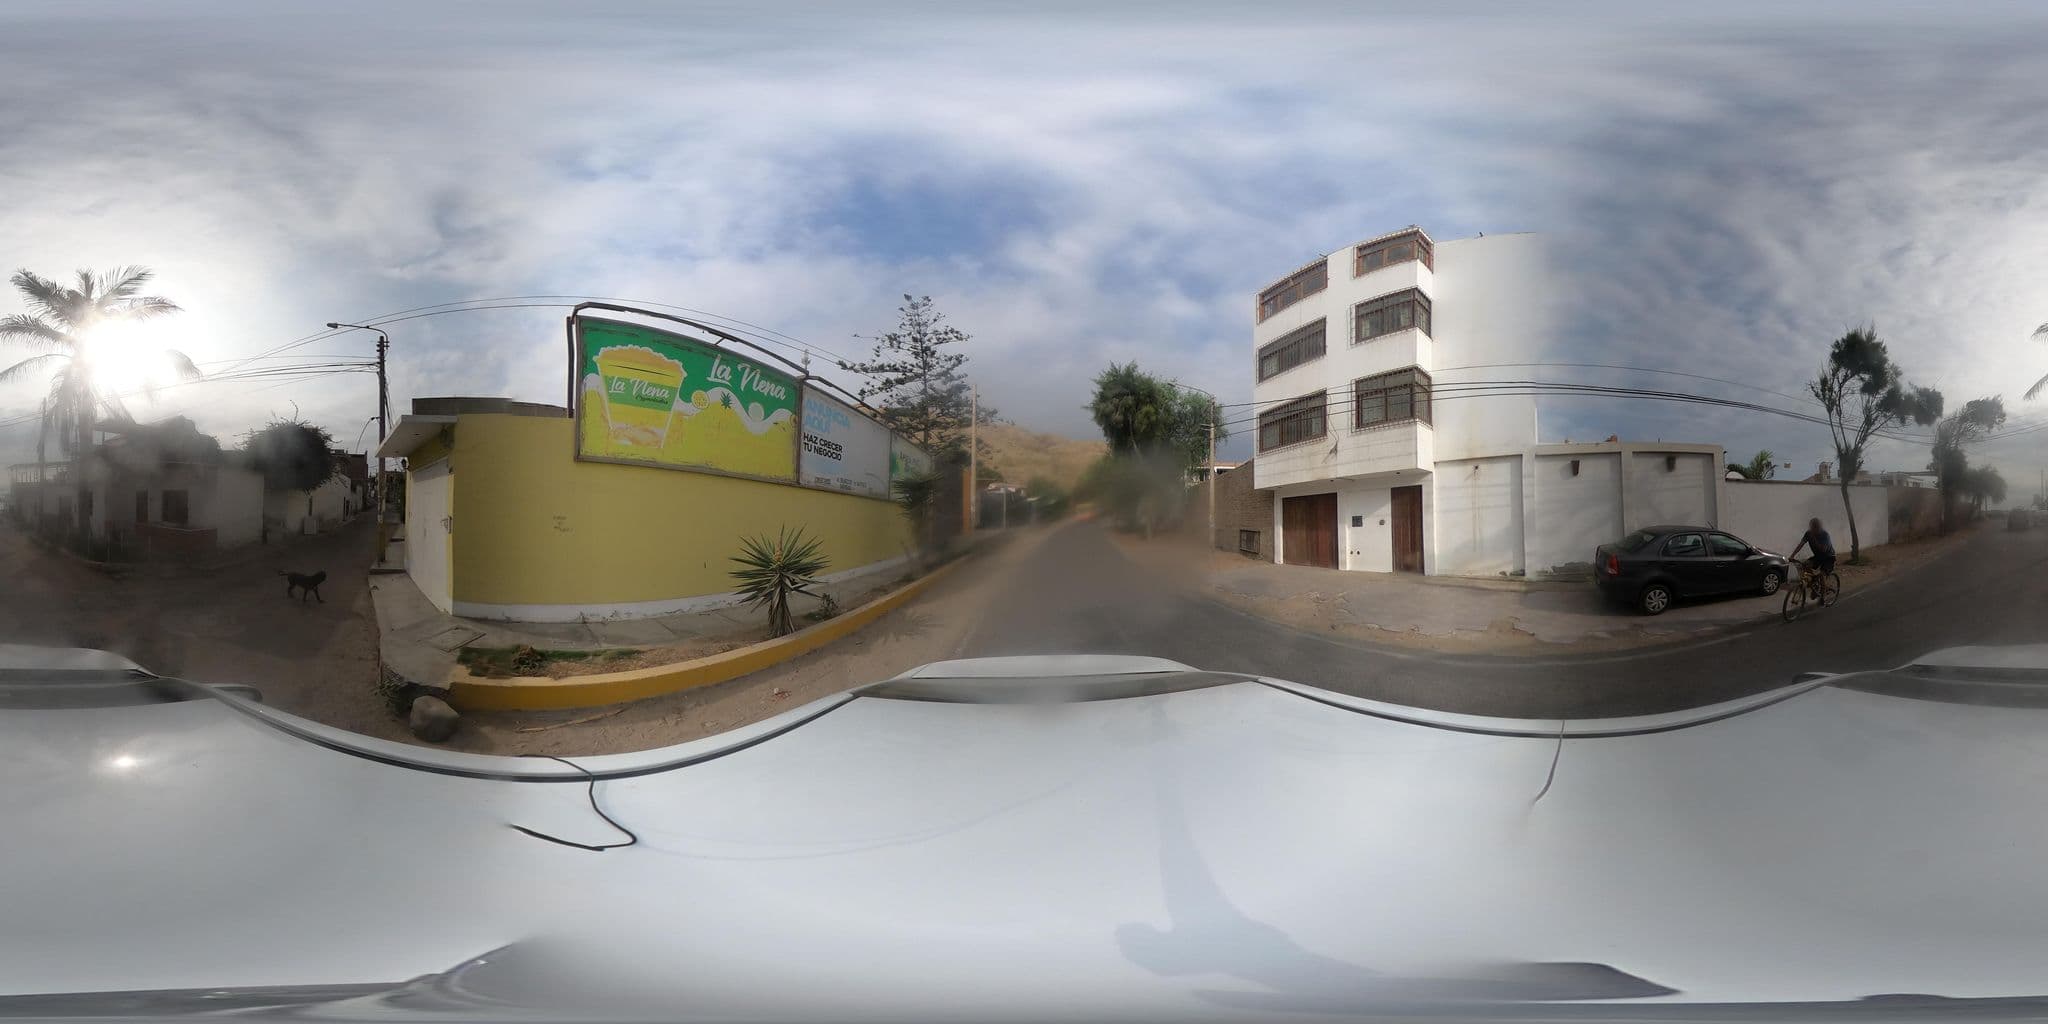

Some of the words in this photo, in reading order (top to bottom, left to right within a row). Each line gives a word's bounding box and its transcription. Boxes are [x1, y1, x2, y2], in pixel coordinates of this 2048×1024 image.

[609, 376, 625, 393] La
[630, 378, 669, 399] Nena
[706, 354, 732, 387] La
[737, 363, 786, 400] Nena
[803, 433, 818, 445] HAZ
[819, 439, 842, 453] CRECER
[803, 442, 812, 452] TU
[813, 446, 841, 461] NEGOCIO
